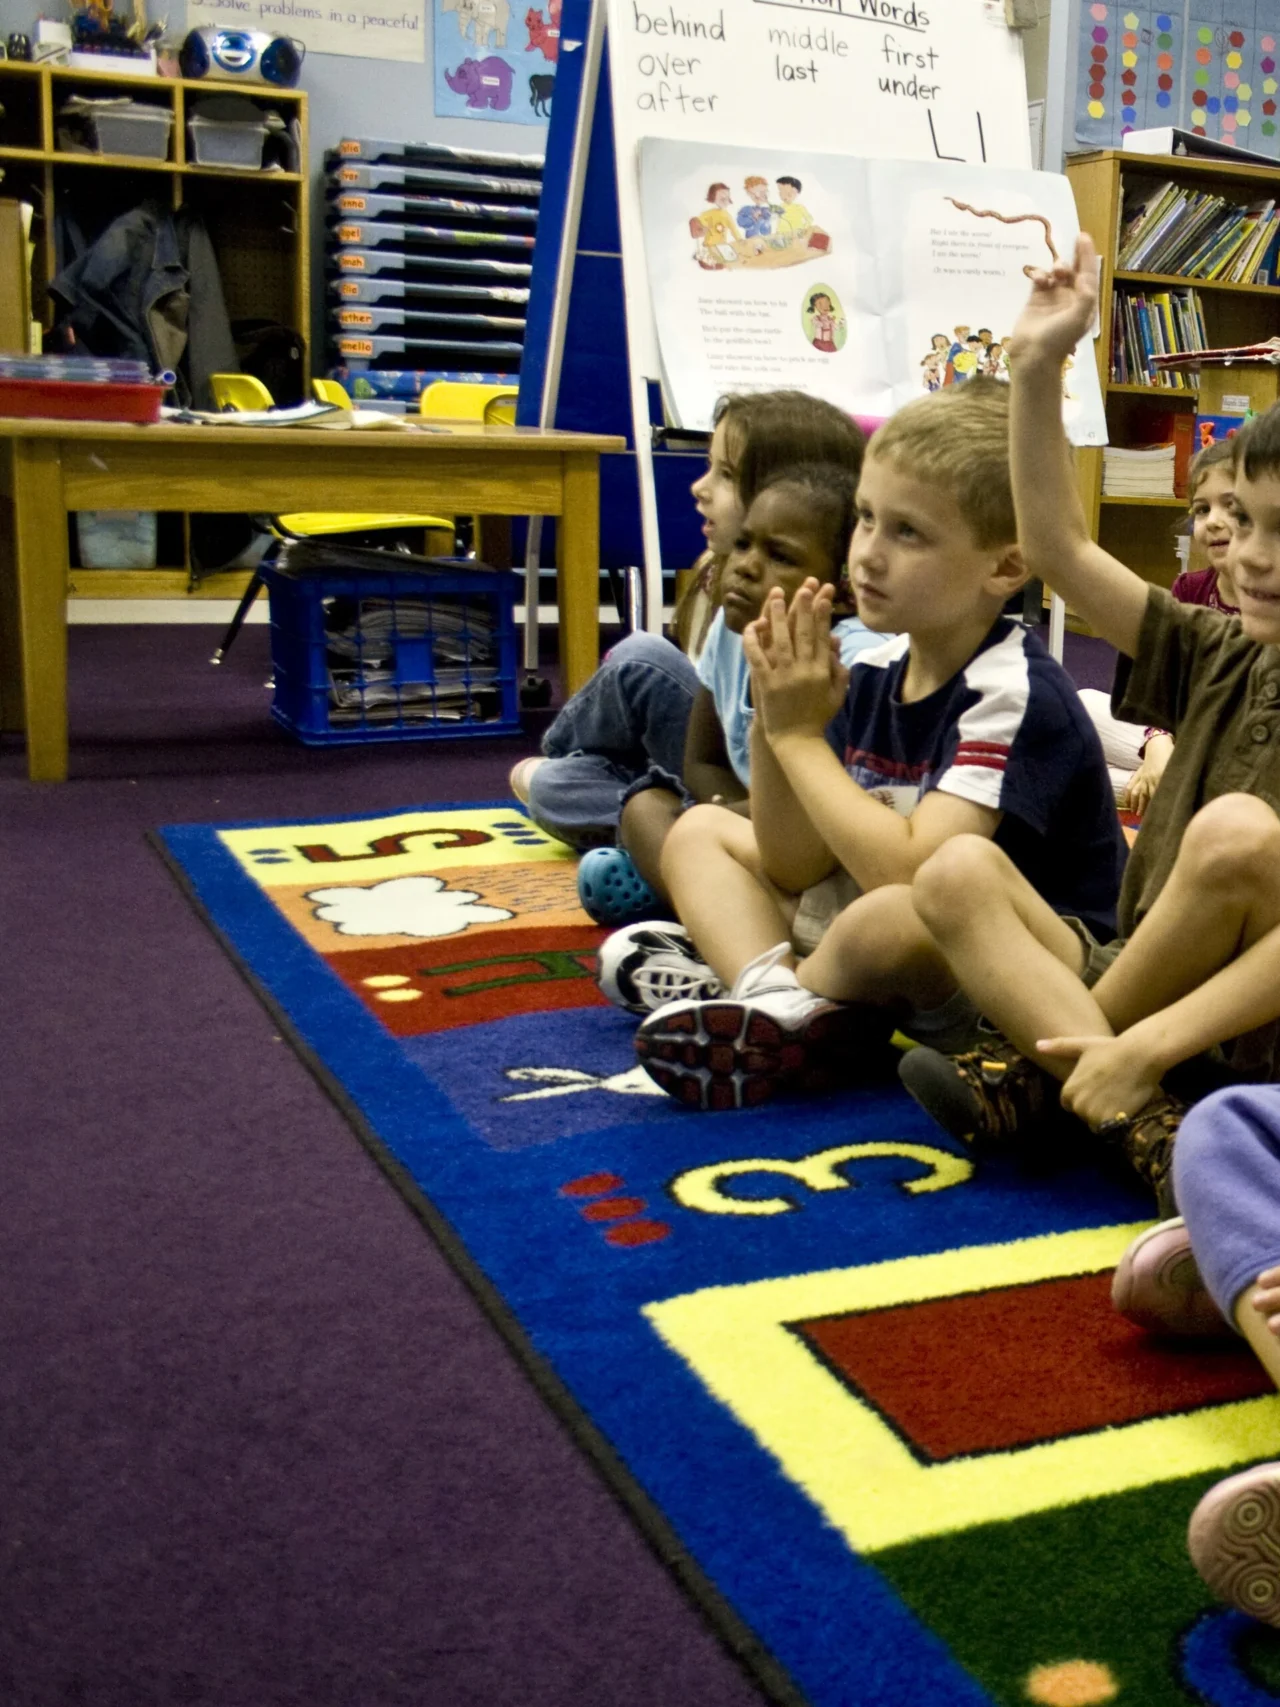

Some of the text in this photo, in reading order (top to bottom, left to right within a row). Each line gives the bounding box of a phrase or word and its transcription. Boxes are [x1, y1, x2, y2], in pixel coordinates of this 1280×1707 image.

[259, 3, 322, 20] problems
[330, 9, 343, 22] in
[363, 14, 419, 30] peaceful
[632, 1, 727, 41] behind
[860, 0, 931, 27] Words
[768, 26, 849, 57] middle
[881, 34, 939, 70] first
[637, 53, 701, 77] over
[775, 55, 819, 83] last
[637, 82, 719, 114] after
[878, 74, 943, 101] under
[666, 1141, 975, 1217] 3
